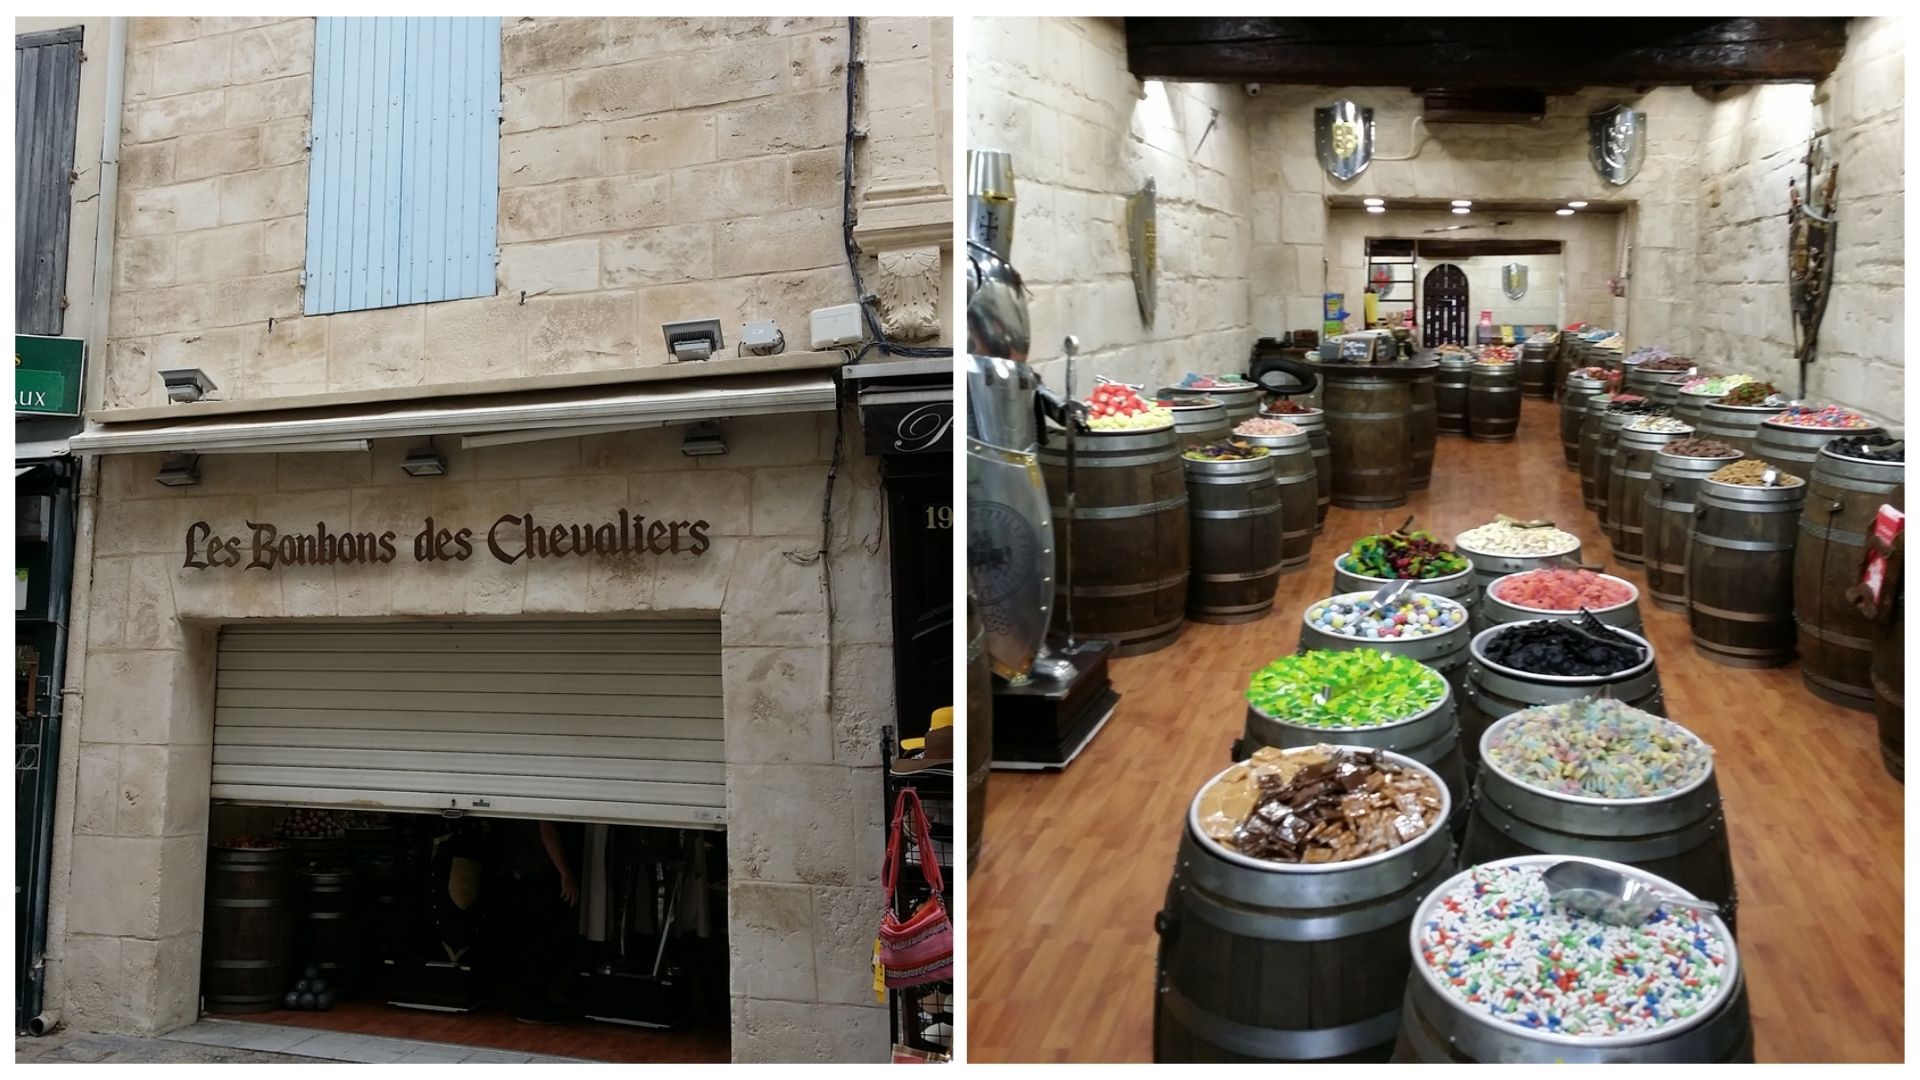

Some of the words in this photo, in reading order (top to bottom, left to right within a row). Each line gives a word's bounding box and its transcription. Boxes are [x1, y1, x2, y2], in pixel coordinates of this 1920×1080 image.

[15, 390, 46, 407] UX
[183, 520, 241, 571] Les
[244, 519, 397, 571] Bonbons
[413, 516, 473, 562] des
[487, 507, 710, 565] Chevaliers
